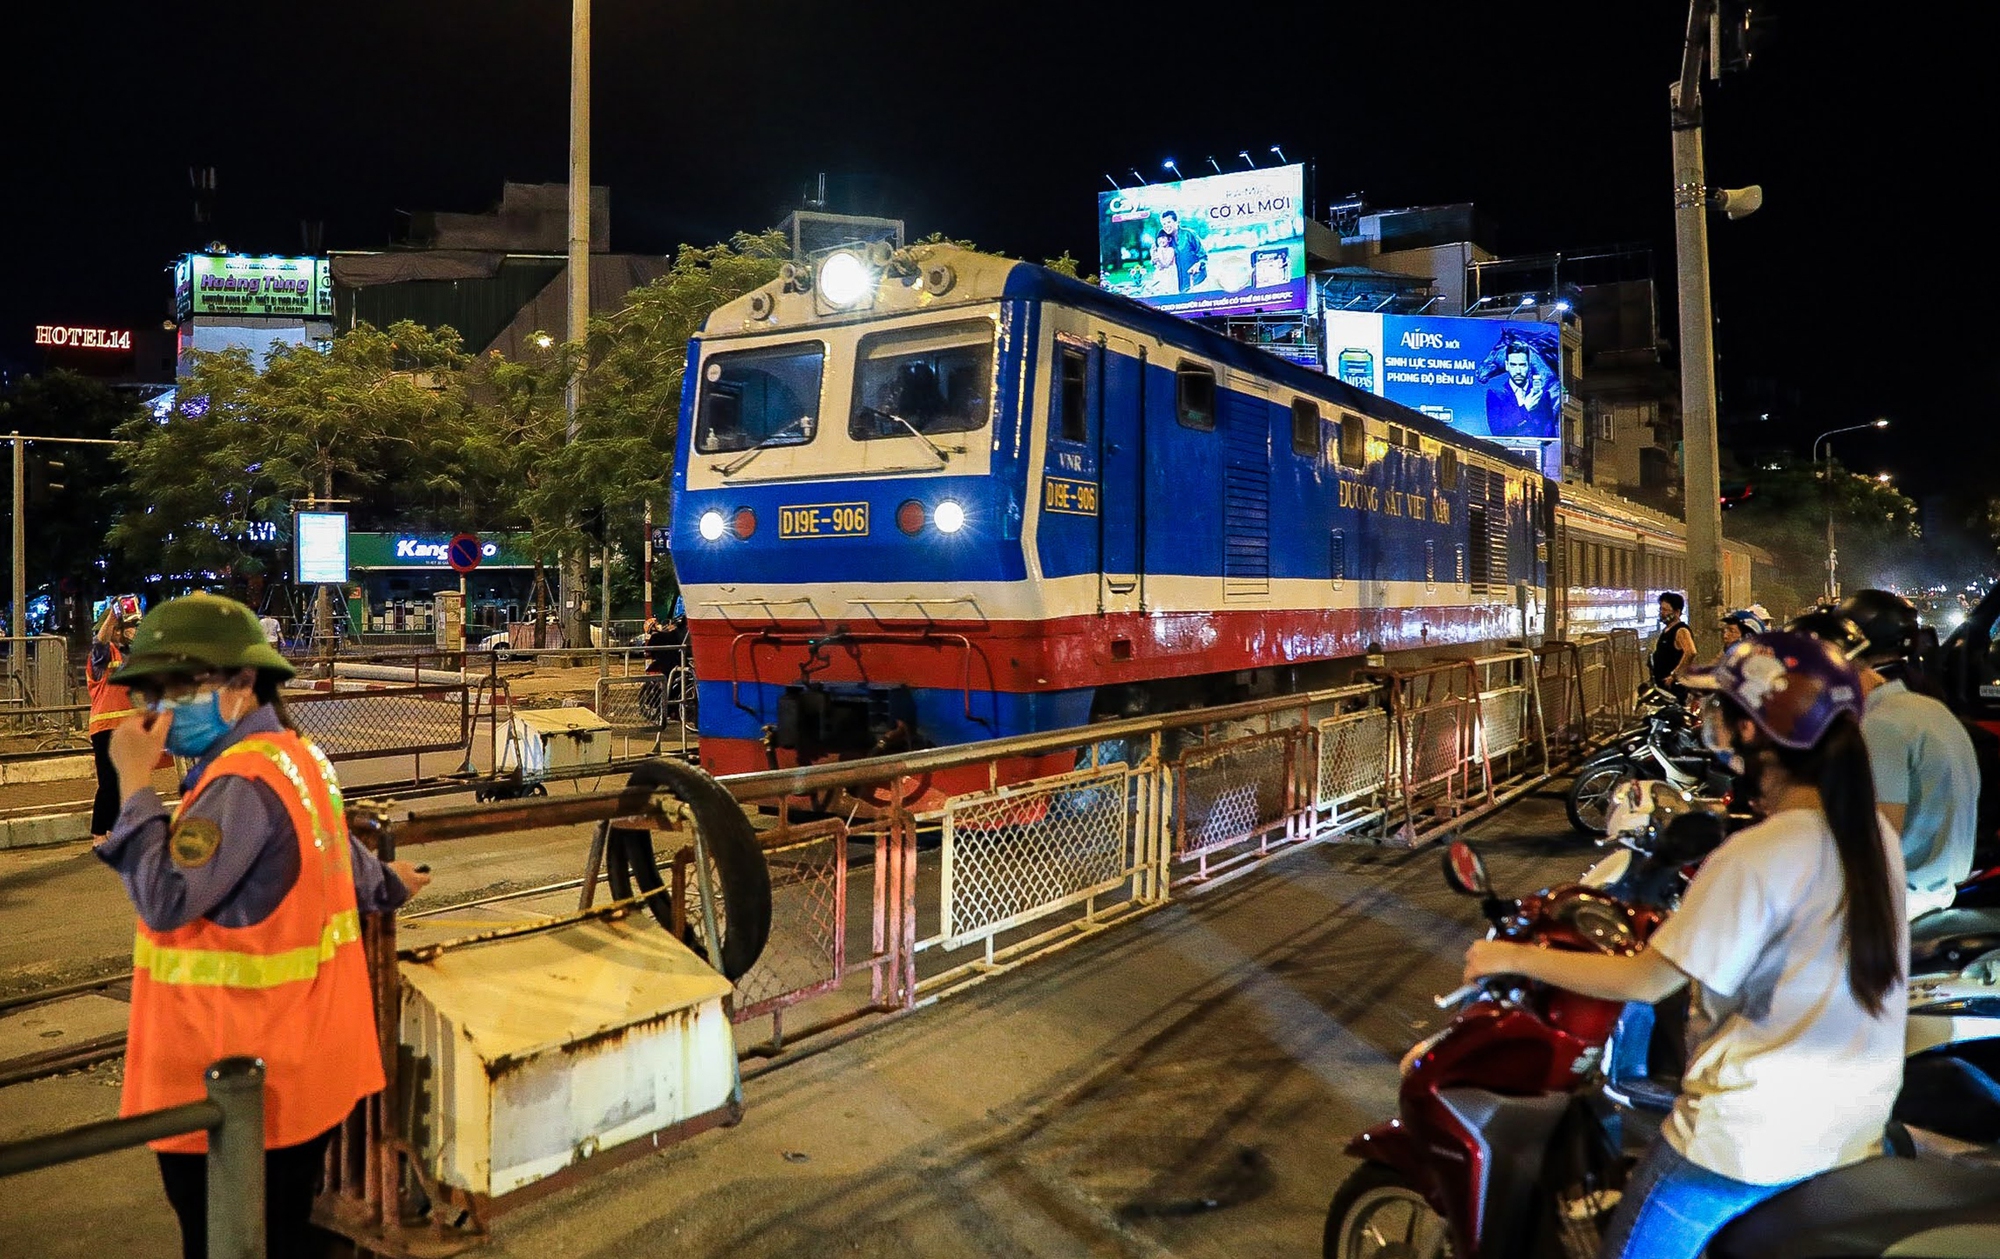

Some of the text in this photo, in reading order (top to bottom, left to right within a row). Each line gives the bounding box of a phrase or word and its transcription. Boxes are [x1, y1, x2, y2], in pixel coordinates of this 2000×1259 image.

[1236, 202, 1255, 216] XL
[263, 274, 309, 296] Tùng
[1385, 356, 1408, 368] SINH
[1427, 359, 1453, 370] SUNG
[1386, 372, 1420, 383] PHONG
[1047, 481, 1096, 511] D19E-906
[782, 507, 866, 534] D19E-906
